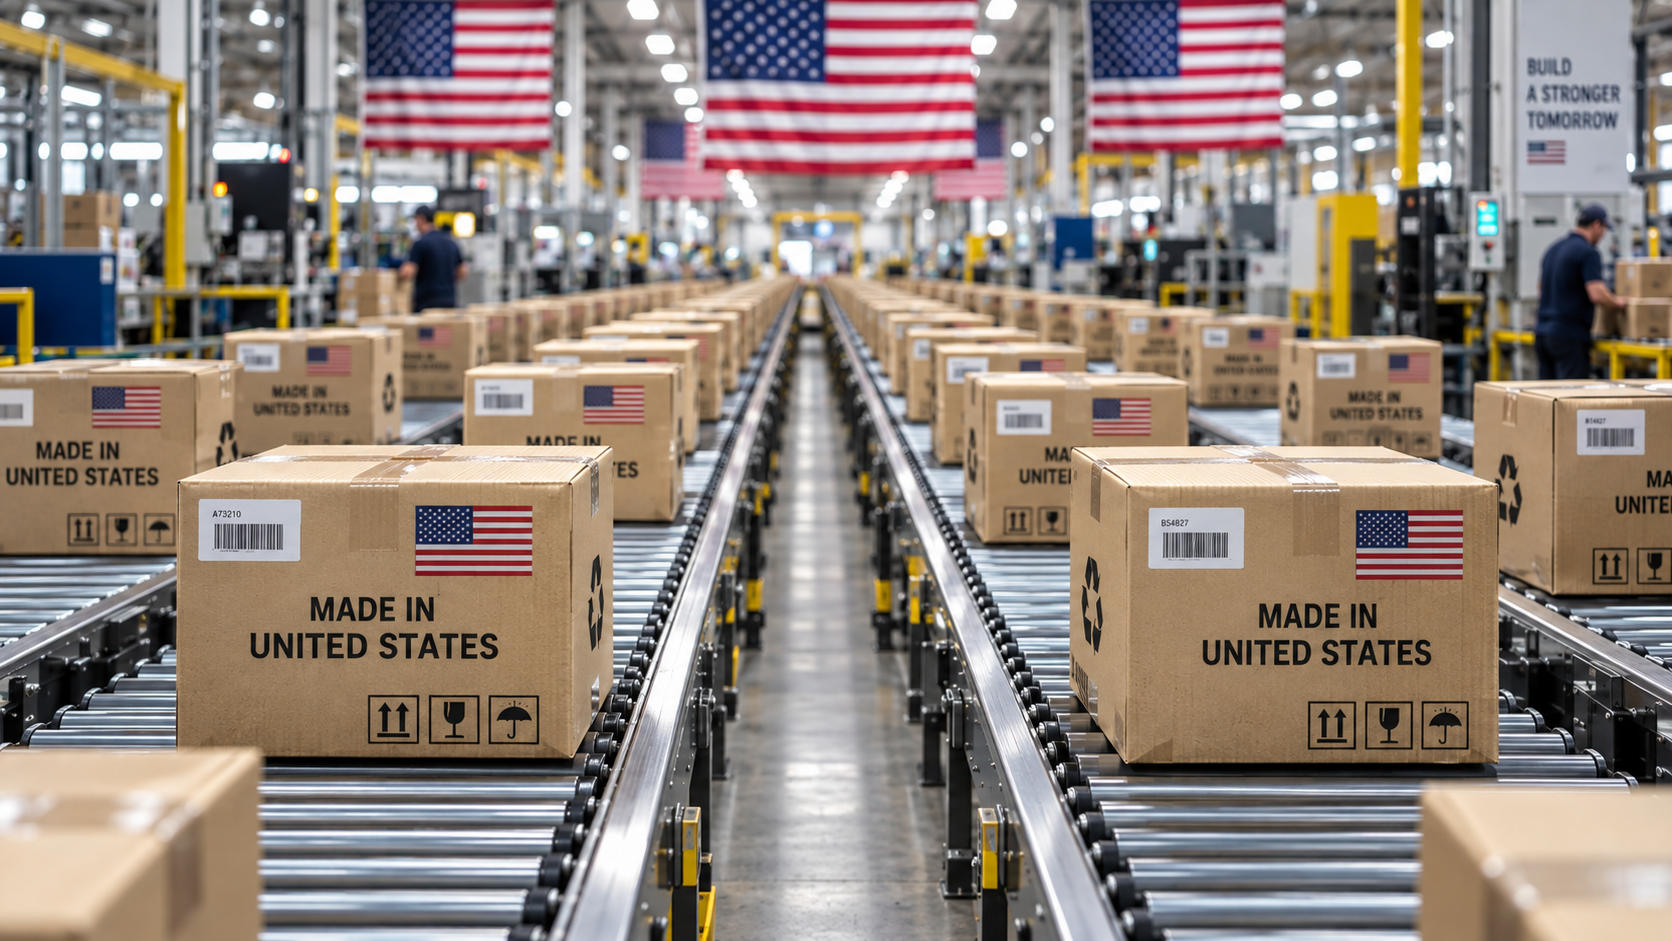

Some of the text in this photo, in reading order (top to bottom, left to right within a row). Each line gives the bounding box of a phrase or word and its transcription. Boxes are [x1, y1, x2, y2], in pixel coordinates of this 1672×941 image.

[1526, 57, 1572, 76] BUILD
[1526, 84, 1621, 103] A STRONGER
[1527, 110, 1619, 130] TOMORROW
[271, 384, 328, 399] MADE IN
[1347, 390, 1401, 404] MADE IN
[252, 401, 351, 417] UNITED STATES
[1329, 406, 1424, 421] UNITED STATES
[36, 441, 120, 460] MADE IN
[1045, 447, 1071, 462] MA
[6, 467, 159, 486] UNITED STATES
[1019, 468, 1072, 485] UNITE
[1646, 470, 1672, 488] MA
[1615, 496, 1672, 514] UNITE
[212, 510, 241, 519] A73210
[310, 597, 435, 622] MADE IN
[1258, 603, 1378, 629] MADE IN
[250, 632, 499, 660] UNITED STATES
[1202, 639, 1432, 667] UNITED STATES
